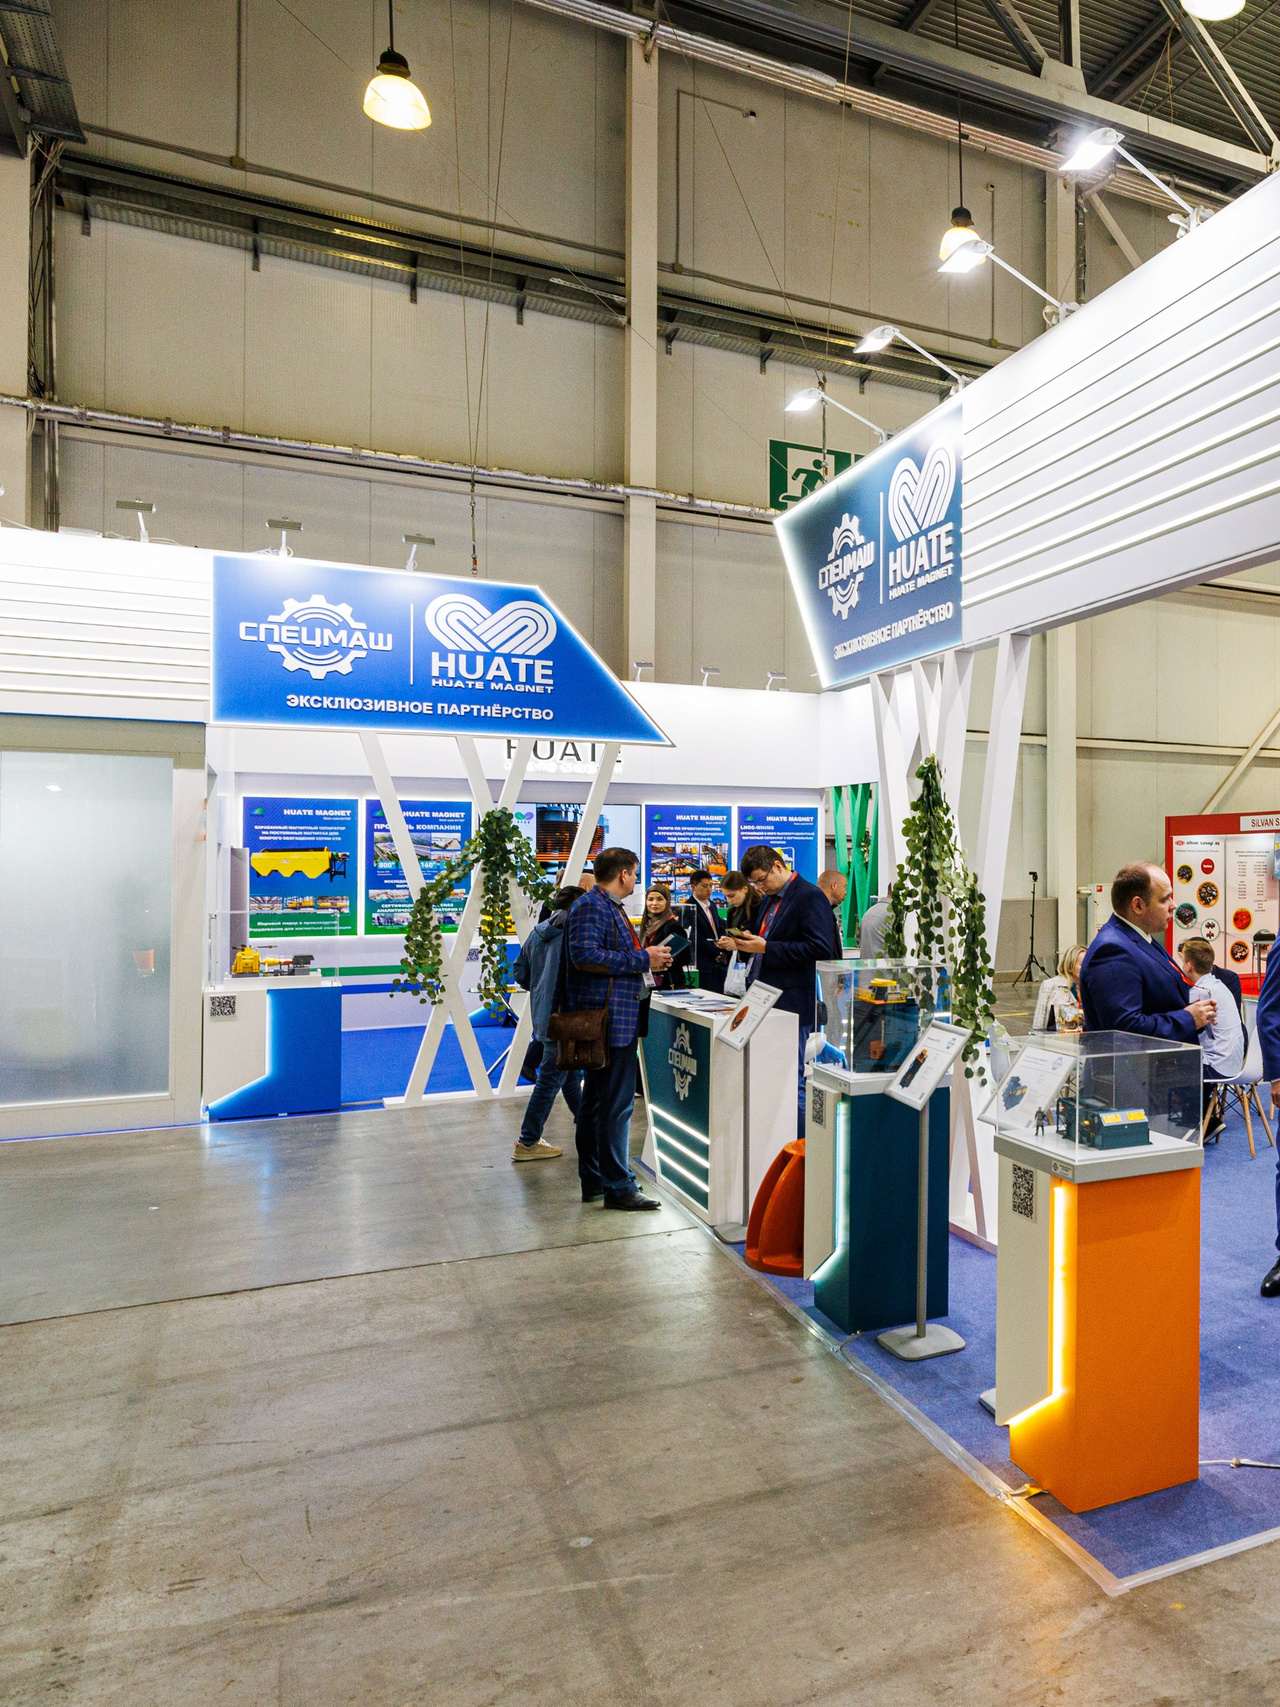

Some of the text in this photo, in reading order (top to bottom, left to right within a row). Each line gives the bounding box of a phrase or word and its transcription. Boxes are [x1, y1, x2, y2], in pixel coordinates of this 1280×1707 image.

[818, 541, 875, 591] СПЕЦМАШ
[888, 522, 955, 587] HUATE
[889, 563, 955, 600] HUATE MAGNET
[239, 621, 393, 652] СПЕЦМАШ
[833, 601, 954, 660] ЭКСКЛЮЗИВНОЕ ПАРТНЁРСТВО
[431, 651, 554, 685] HUATE
[431, 679, 554, 694] HUATE MAGNET
[286, 694, 554, 721] ЭКСКЛЮЗИВНОЕ ПАРТНЁРСТВО
[315, 809, 352, 817] MAGNET
